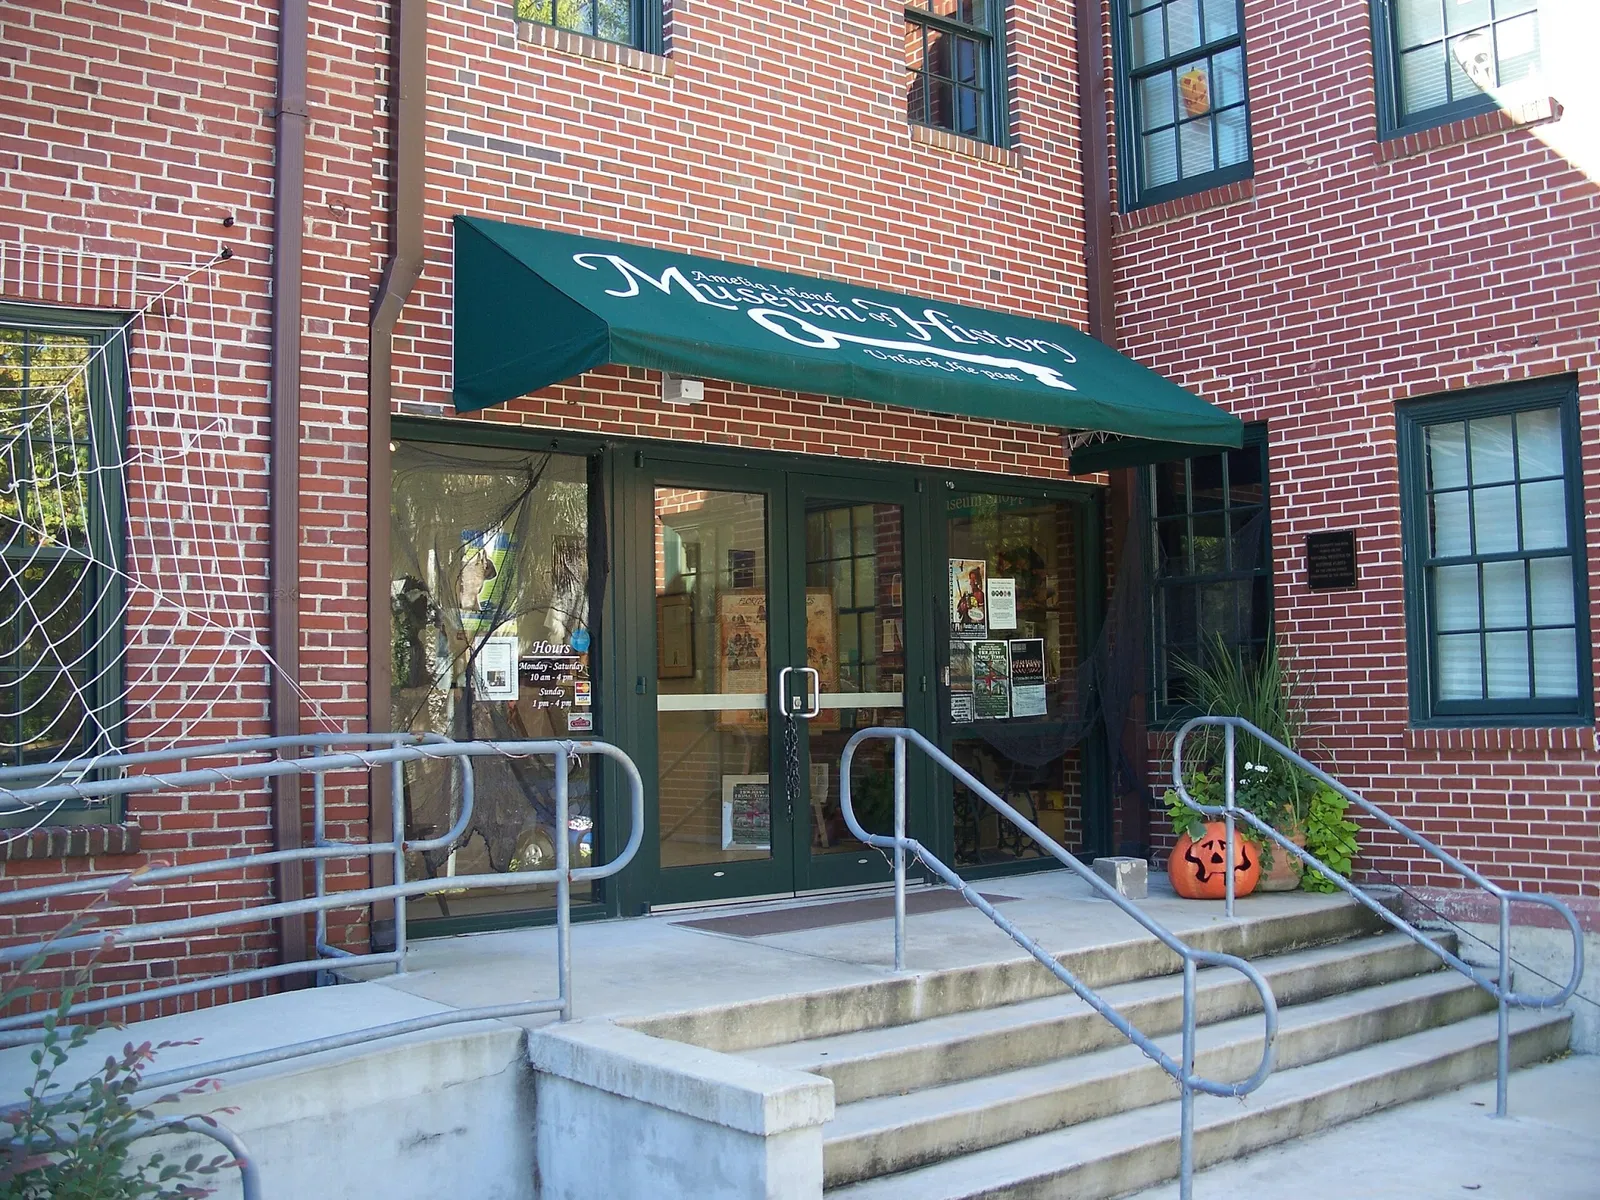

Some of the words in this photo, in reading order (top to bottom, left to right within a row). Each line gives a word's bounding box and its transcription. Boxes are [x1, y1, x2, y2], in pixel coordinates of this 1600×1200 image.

[572, 253, 867, 323] Museum
[691, 271, 769, 292] Amelia
[770, 284, 839, 304] Island
[868, 312, 898, 328] of
[851, 298, 1077, 364] History
[864, 349, 954, 372] Unlock
[945, 360, 979, 375] the
[980, 369, 1024, 383] past
[532, 640, 571, 654] Hours
[519, 661, 548, 672] Monday
[552, 661, 584, 672] Saturday
[530, 673, 540, 681] 10
[556, 673, 562, 681] 4
[562, 674, 573, 683] pm
[539, 687, 565, 697] Sunday
[537, 700, 549, 709] pm
[560, 700, 572, 709] pm
